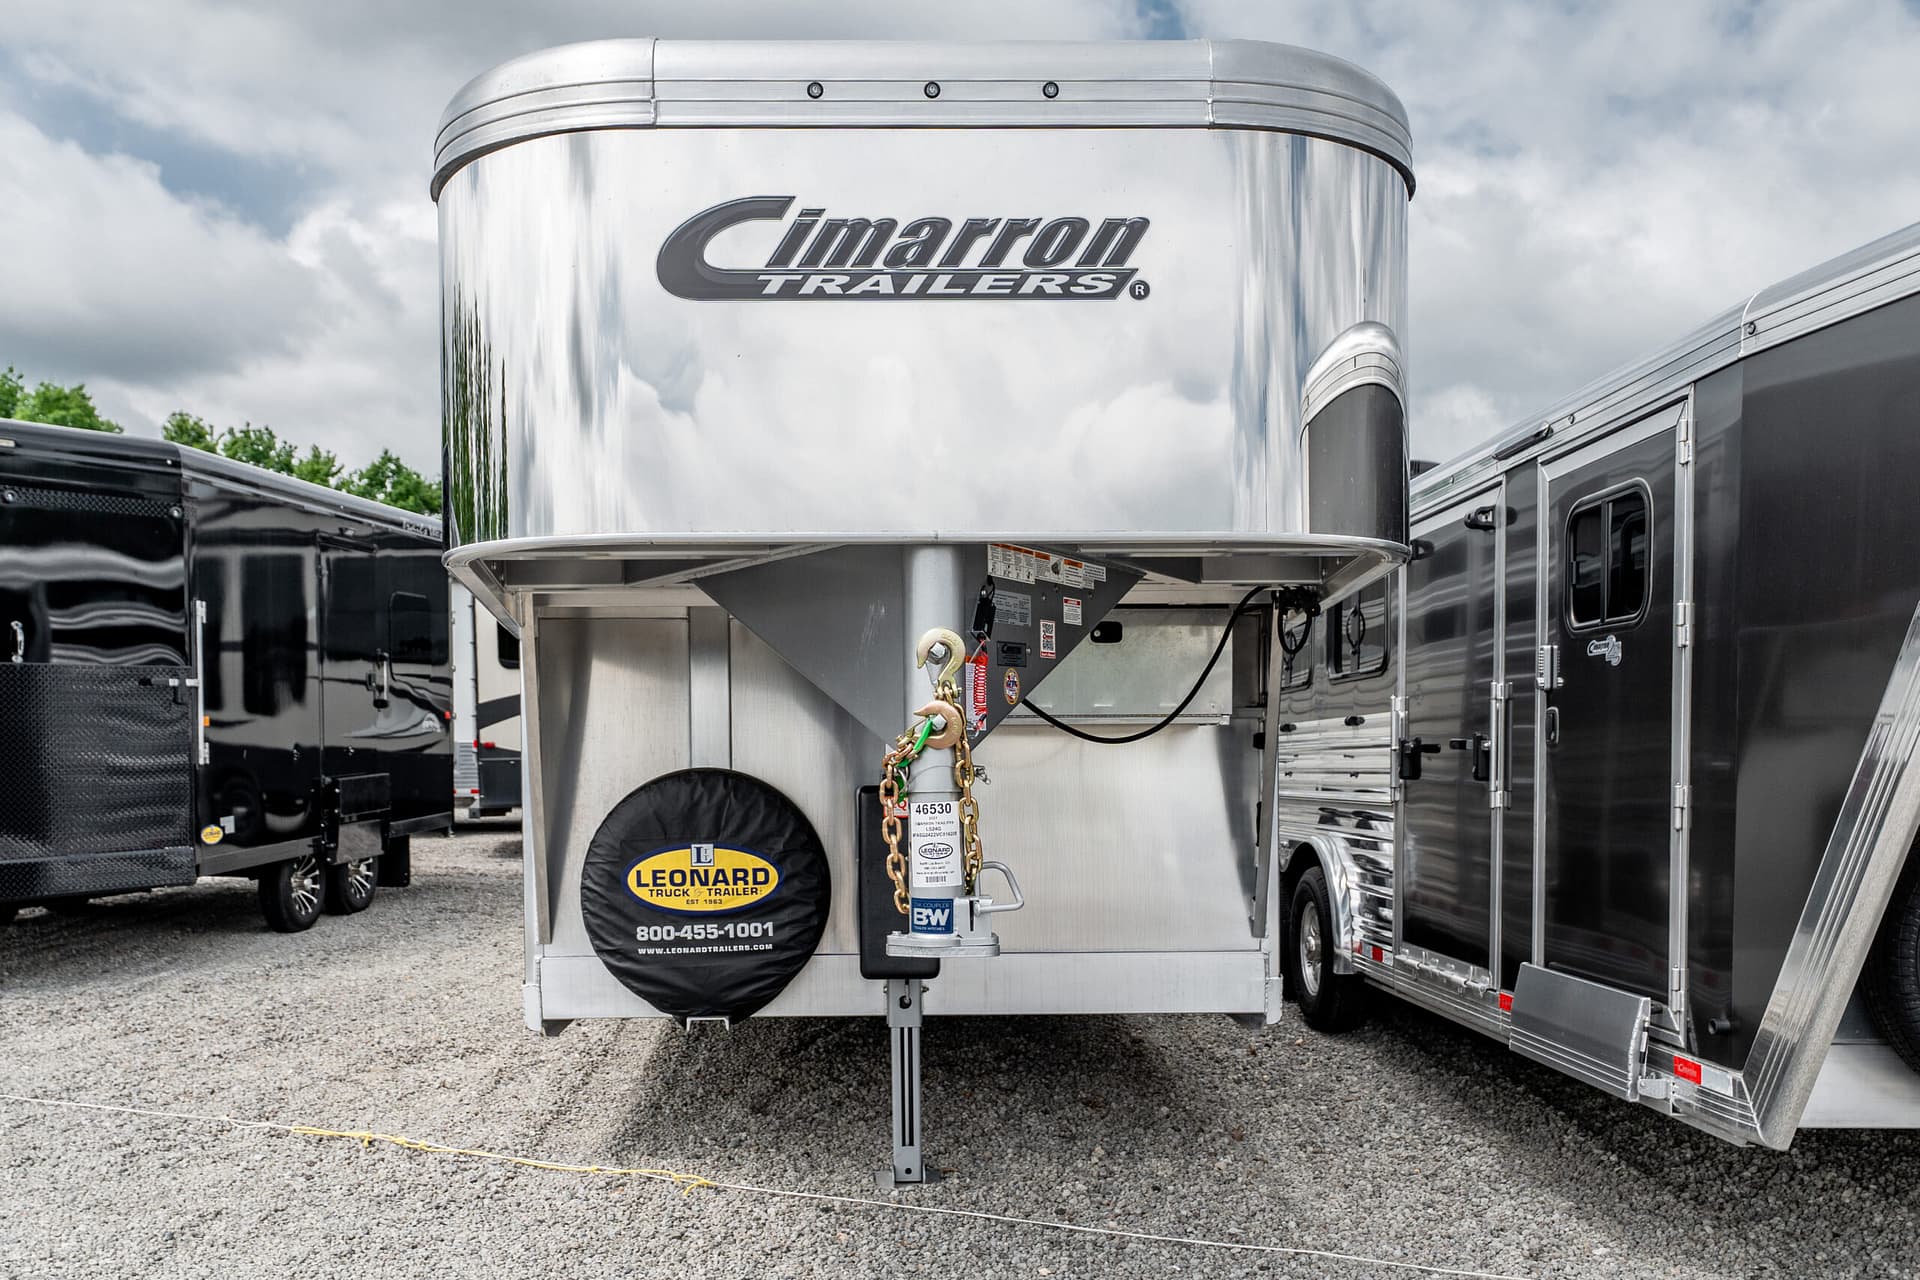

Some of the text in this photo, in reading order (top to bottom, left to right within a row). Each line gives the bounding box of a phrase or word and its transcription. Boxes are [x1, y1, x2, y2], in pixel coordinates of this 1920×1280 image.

[656, 195, 1150, 301] Cimarron
[757, 273, 1118, 295] TRAILERS
[915, 803, 952, 815] 46530
[636, 868, 770, 888] LEONARD
[648, 888, 690, 897] TRUCK
[706, 887, 759, 897] TRAILER
[636, 921, 774, 942] 800-455-1001
[638, 943, 773, 954] WWW.LEONARDTRAILERS.COM
